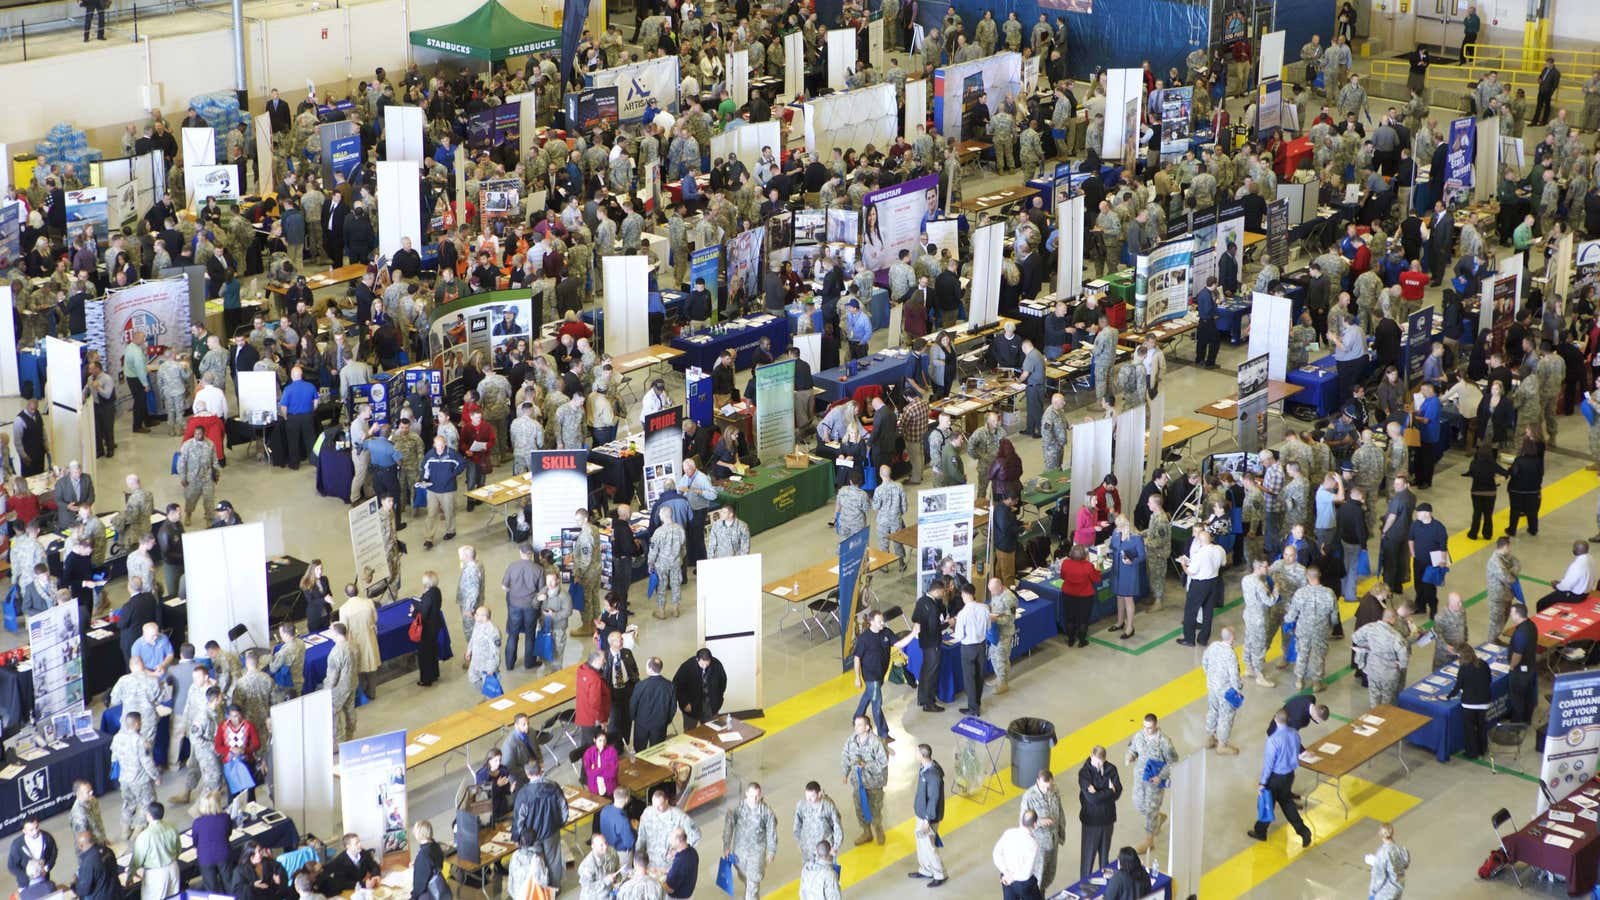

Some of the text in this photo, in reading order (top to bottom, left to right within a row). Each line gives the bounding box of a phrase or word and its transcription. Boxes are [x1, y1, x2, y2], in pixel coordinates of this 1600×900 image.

[427, 38, 470, 54] STARBUCKS
[508, 39, 556, 55] STARBUCKS
[220, 179, 231, 193] 2
[870, 187, 902, 203] PRIDESTAFF
[649, 411, 677, 432] PRIDE
[542, 455, 577, 470] SKILL
[1572, 687, 1594, 698] TAKE
[1562, 706, 1598, 718] OF YOUR
[1561, 716, 1594, 727] FUTURE
